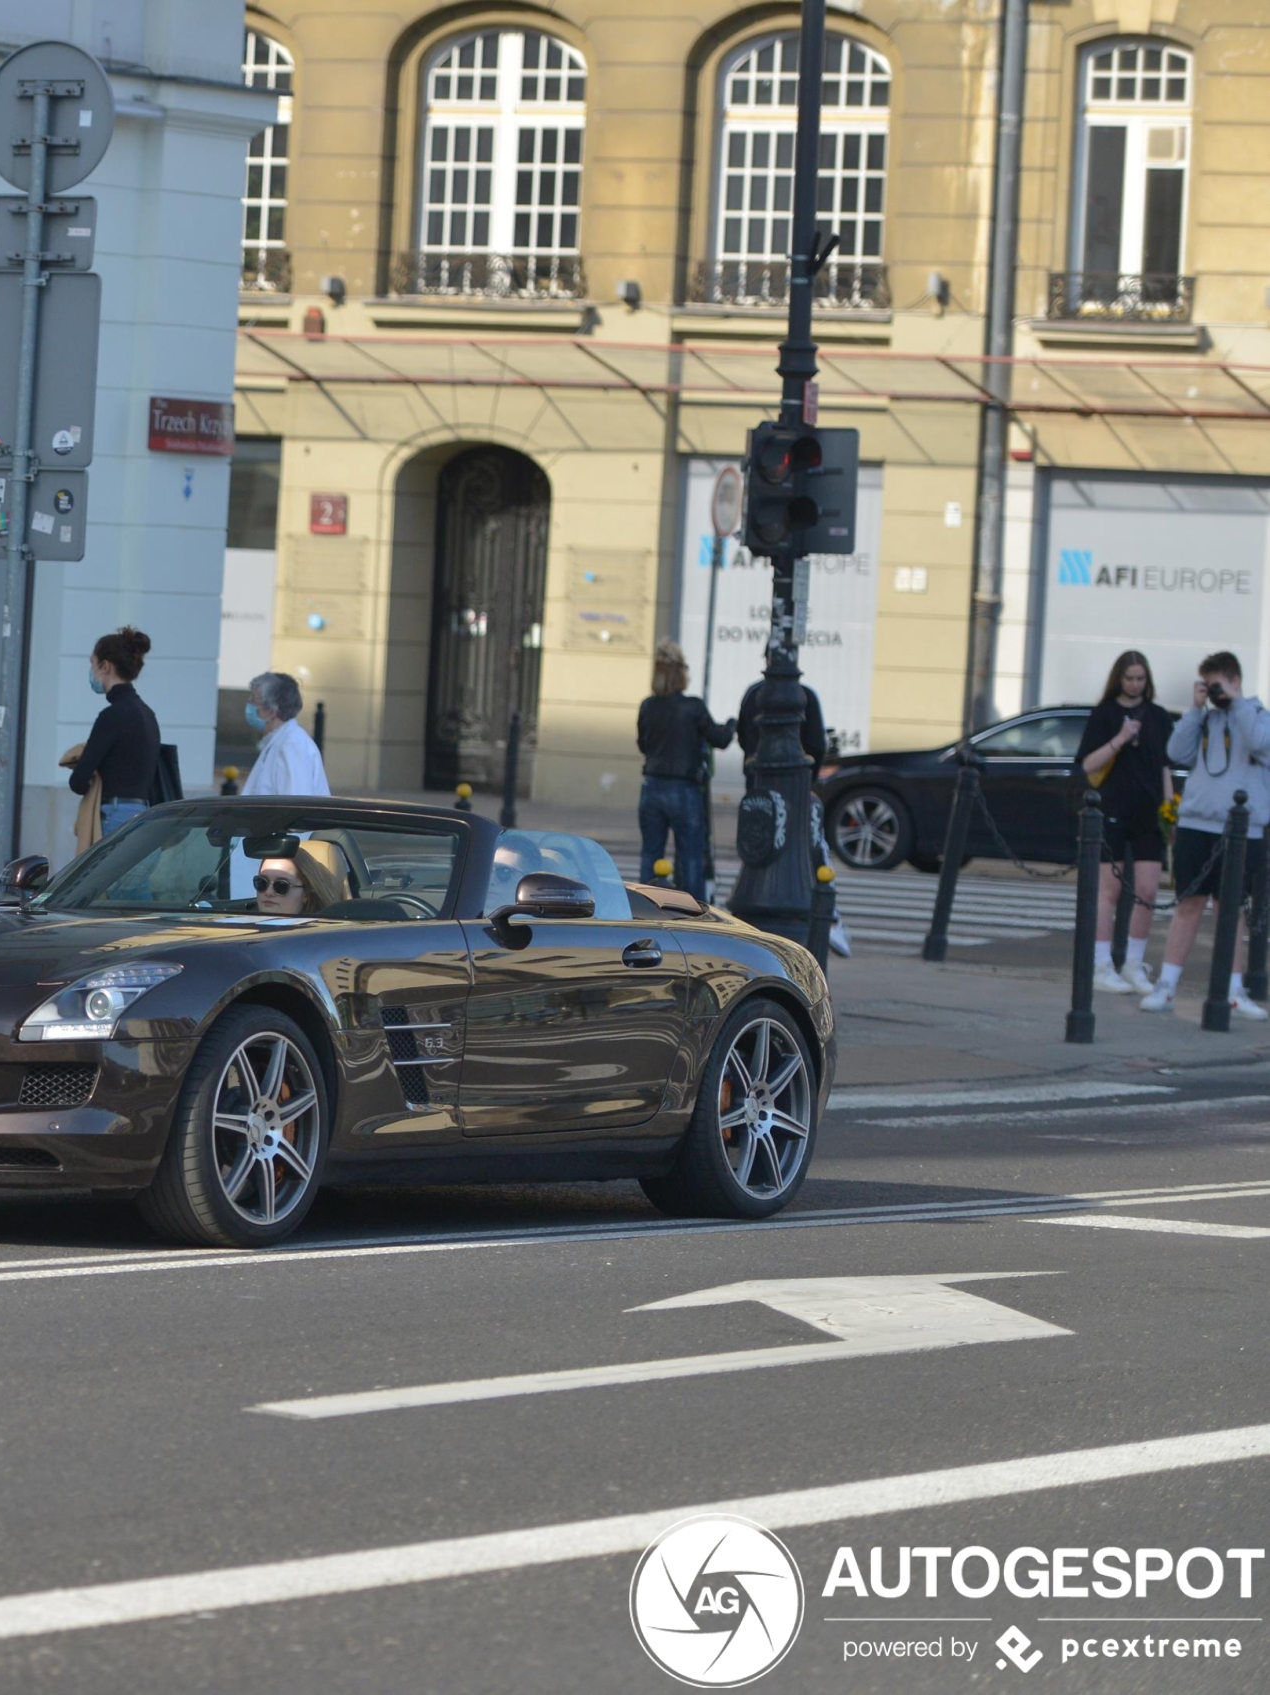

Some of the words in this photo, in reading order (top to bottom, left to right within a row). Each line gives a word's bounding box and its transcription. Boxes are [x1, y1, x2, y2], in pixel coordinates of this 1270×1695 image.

[152, 408, 196, 433] Trzech
[319, 501, 333, 525] 2
[1095, 565, 1138, 588] AFI
[1143, 565, 1252, 595] EUROPE
[718, 626, 743, 643] DO
[424, 1037, 443, 1048] 6.3
